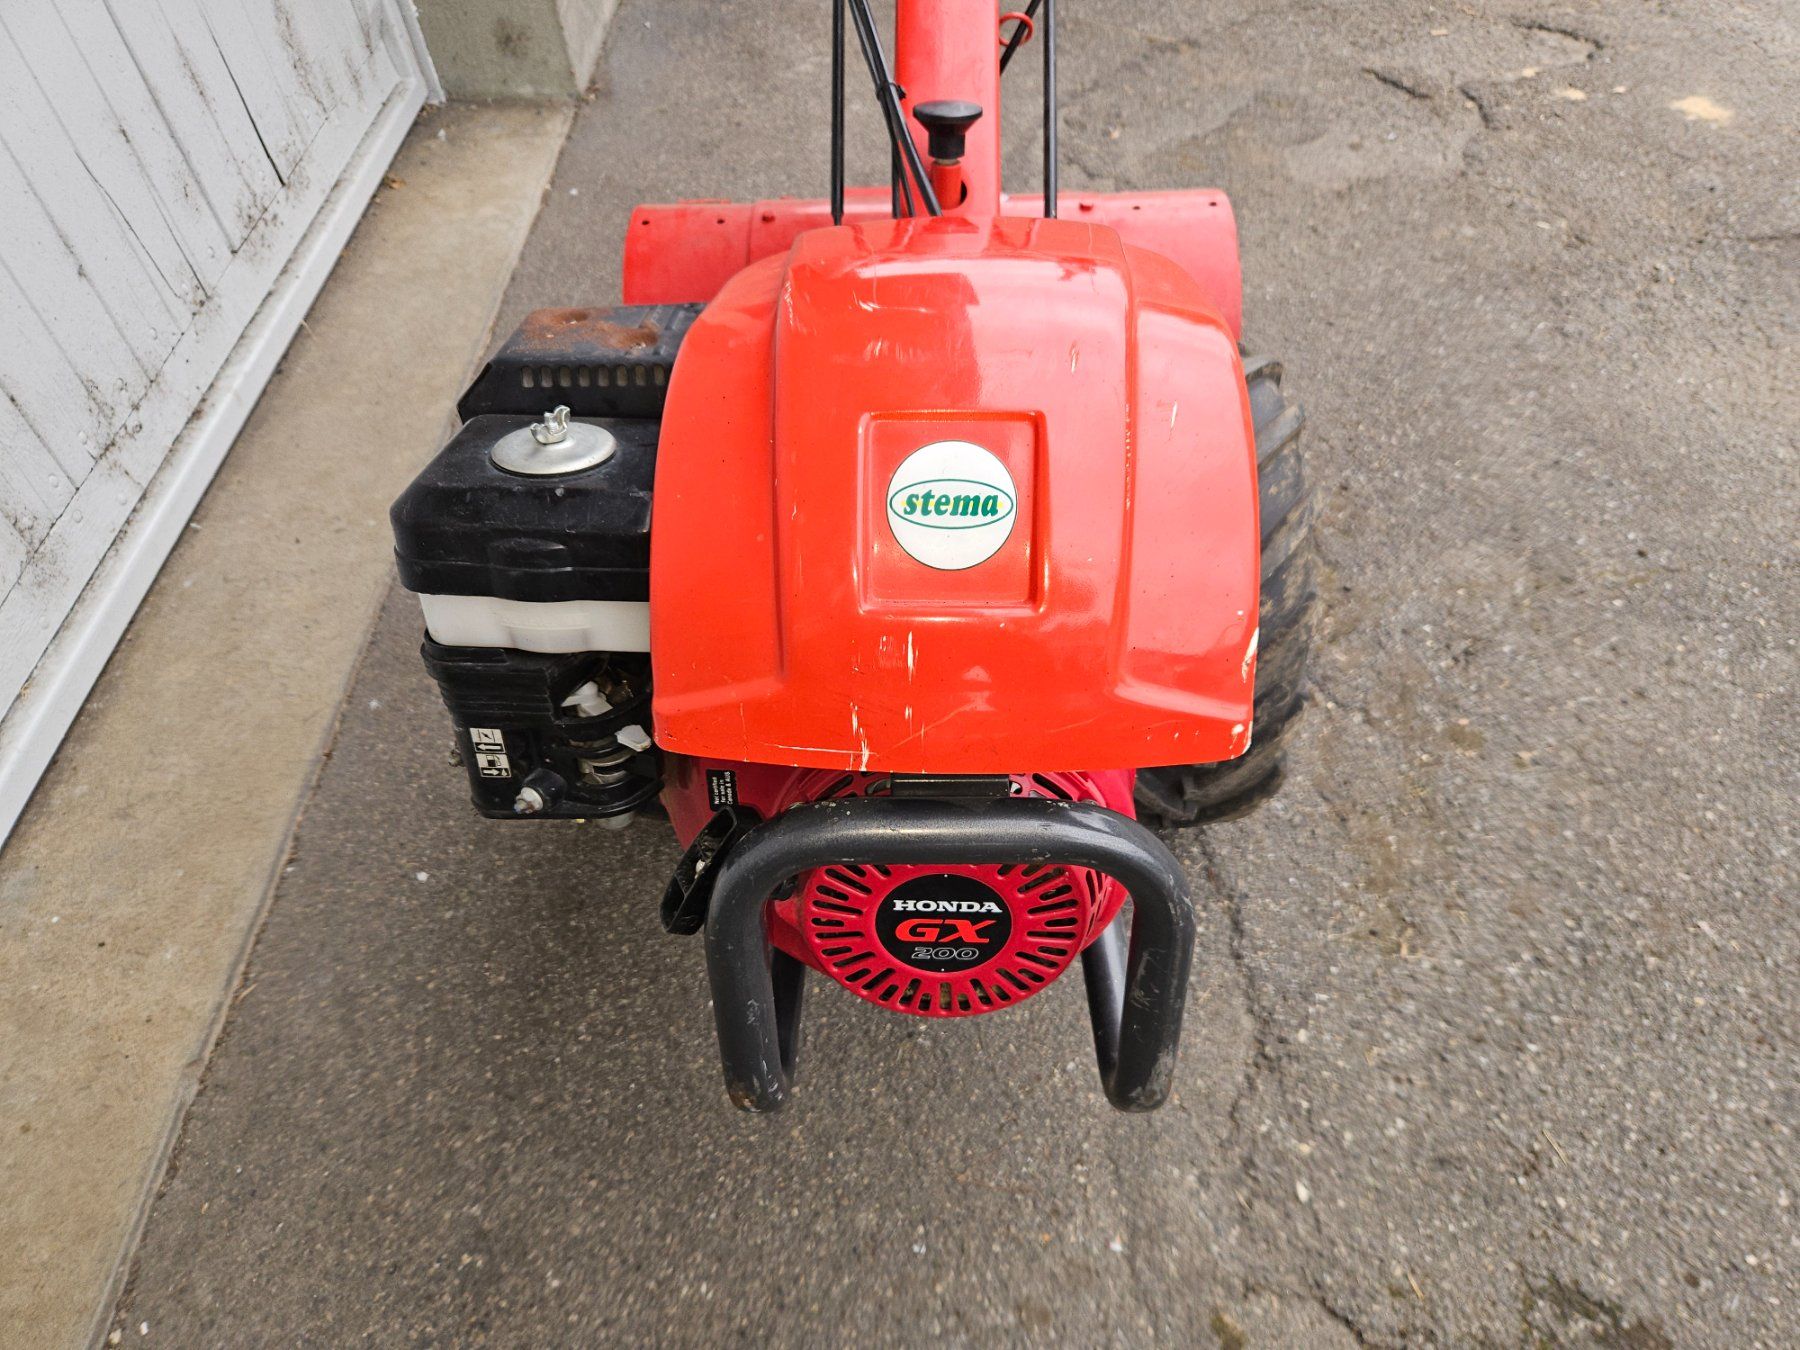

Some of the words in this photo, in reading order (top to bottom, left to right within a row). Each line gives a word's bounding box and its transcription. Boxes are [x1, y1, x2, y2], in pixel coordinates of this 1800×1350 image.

[903, 489, 999, 517] stema
[893, 899, 1003, 913] HONDA
[895, 918, 997, 944] GX
[911, 946, 980, 961] 200
